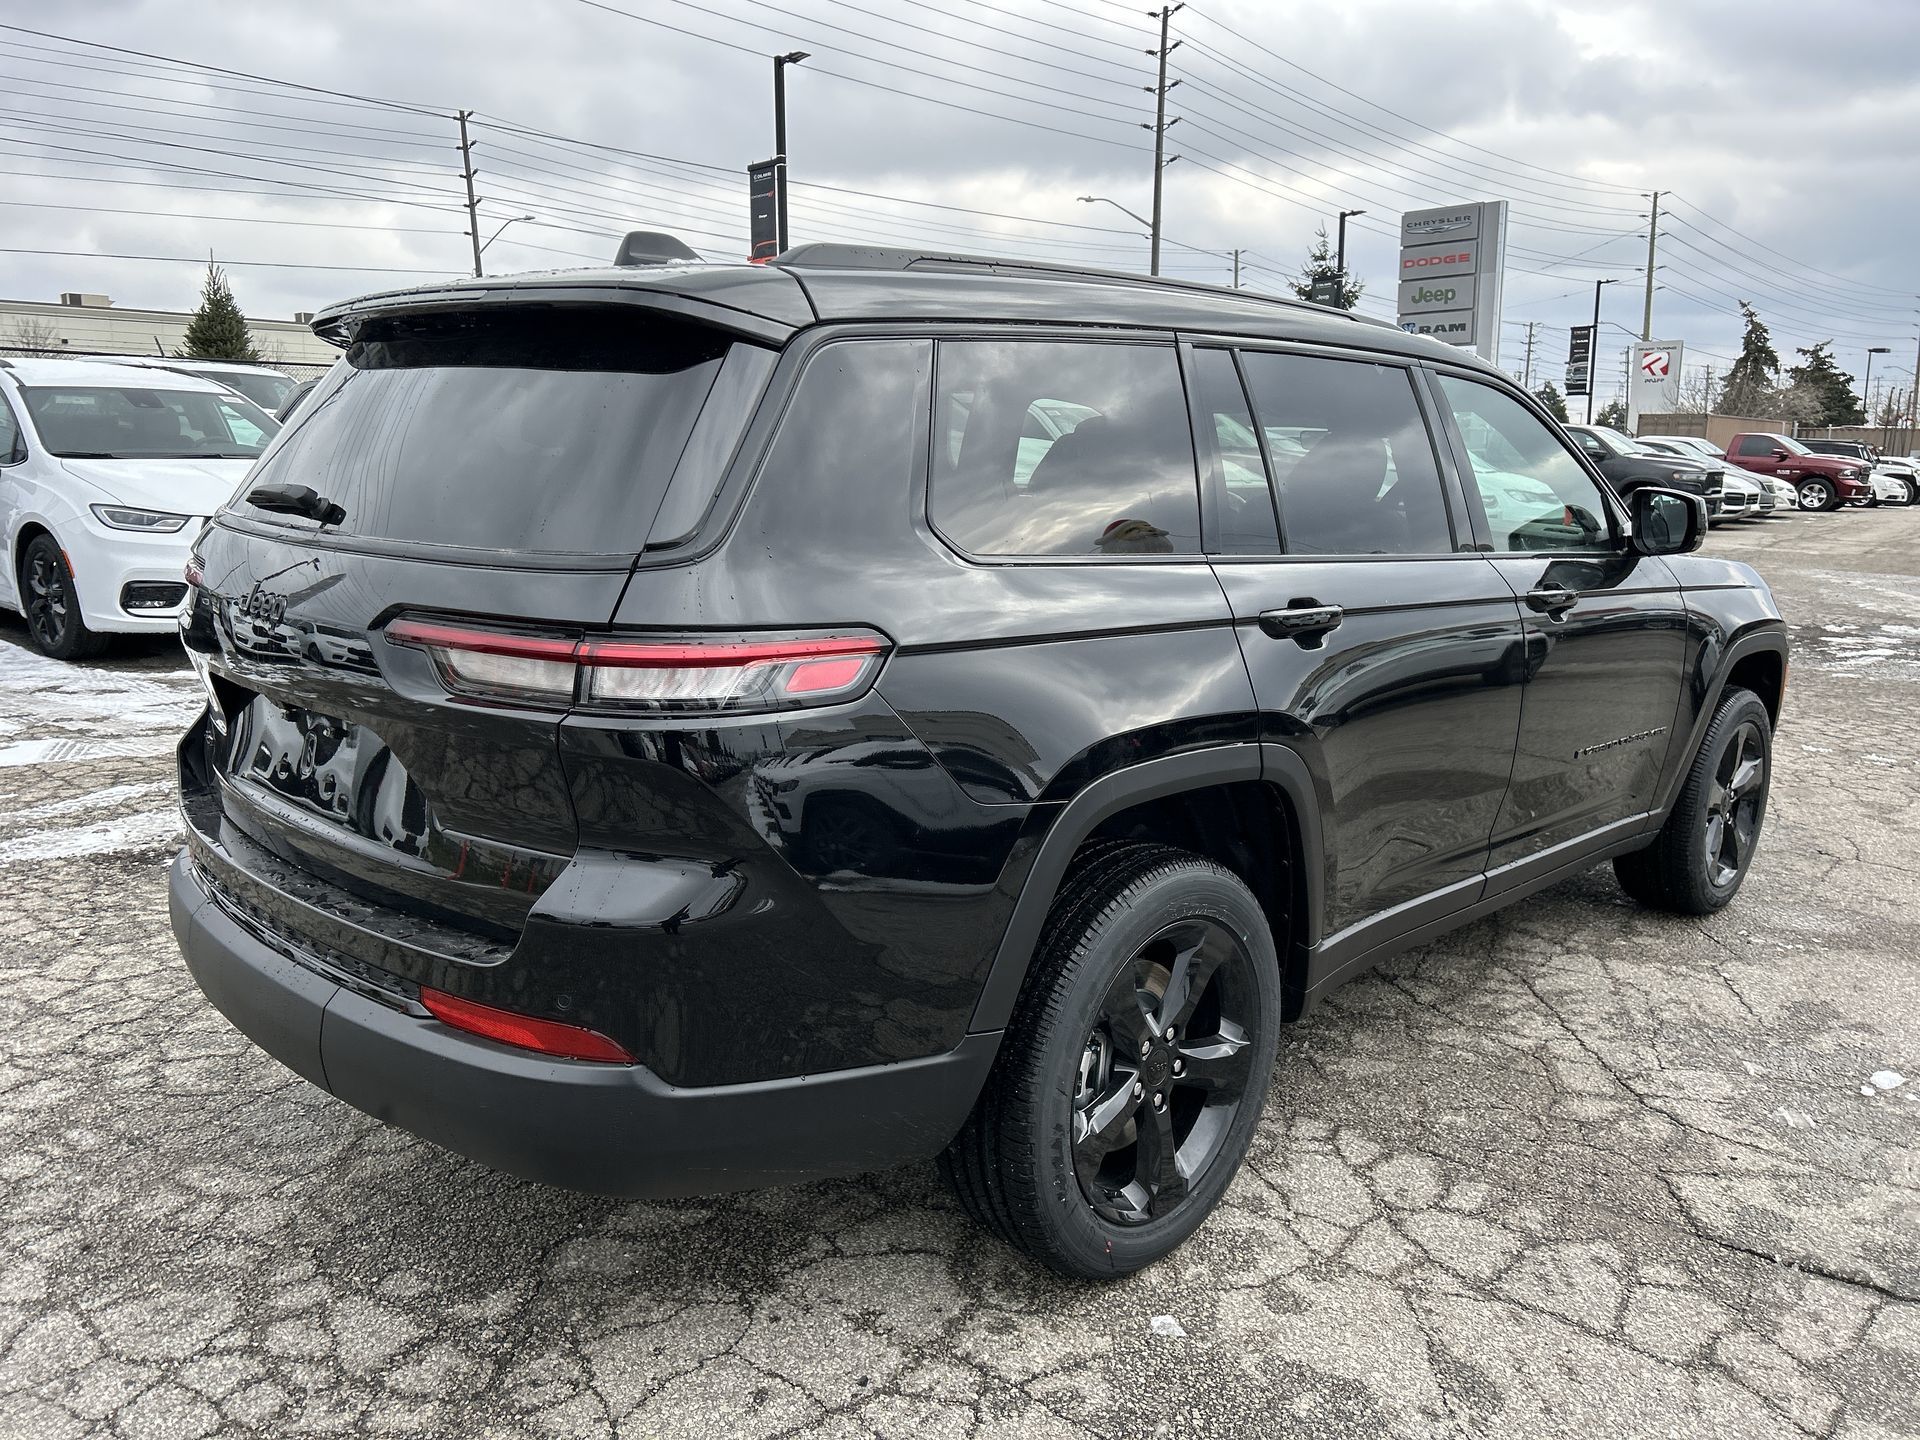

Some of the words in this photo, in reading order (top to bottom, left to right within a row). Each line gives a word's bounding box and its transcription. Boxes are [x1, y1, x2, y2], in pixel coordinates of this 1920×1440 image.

[1406, 215, 1472, 228] CHRYSLER
[1403, 253, 1471, 268] DODGE
[1411, 286, 1456, 305] Jeep
[1418, 322, 1467, 334] RAM
[239, 580, 288, 632] Jeep
